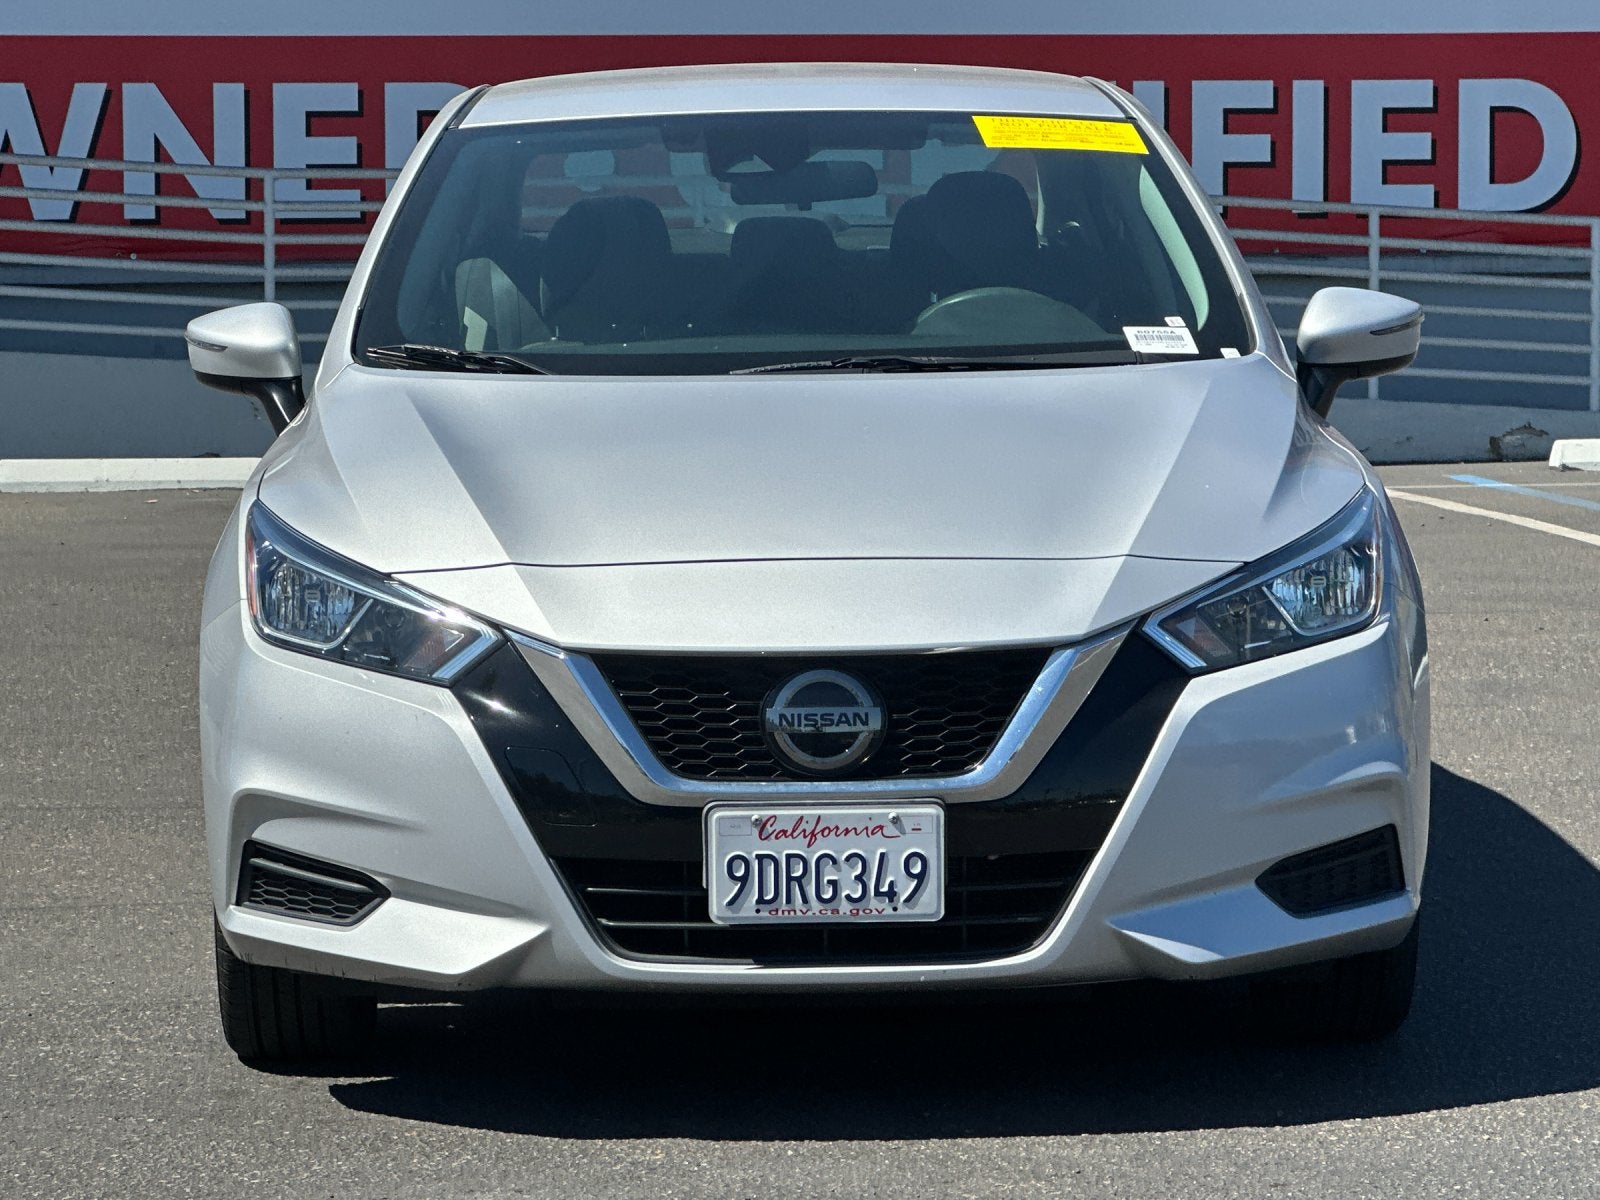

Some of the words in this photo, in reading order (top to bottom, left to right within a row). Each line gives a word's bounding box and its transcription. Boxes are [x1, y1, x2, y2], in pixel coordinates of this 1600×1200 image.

[778, 711, 869, 728] NISSAN
[757, 814, 901, 849] California
[725, 850, 929, 907] 9DRG349
[767, 906, 887, 917] dmv.ca.gov
